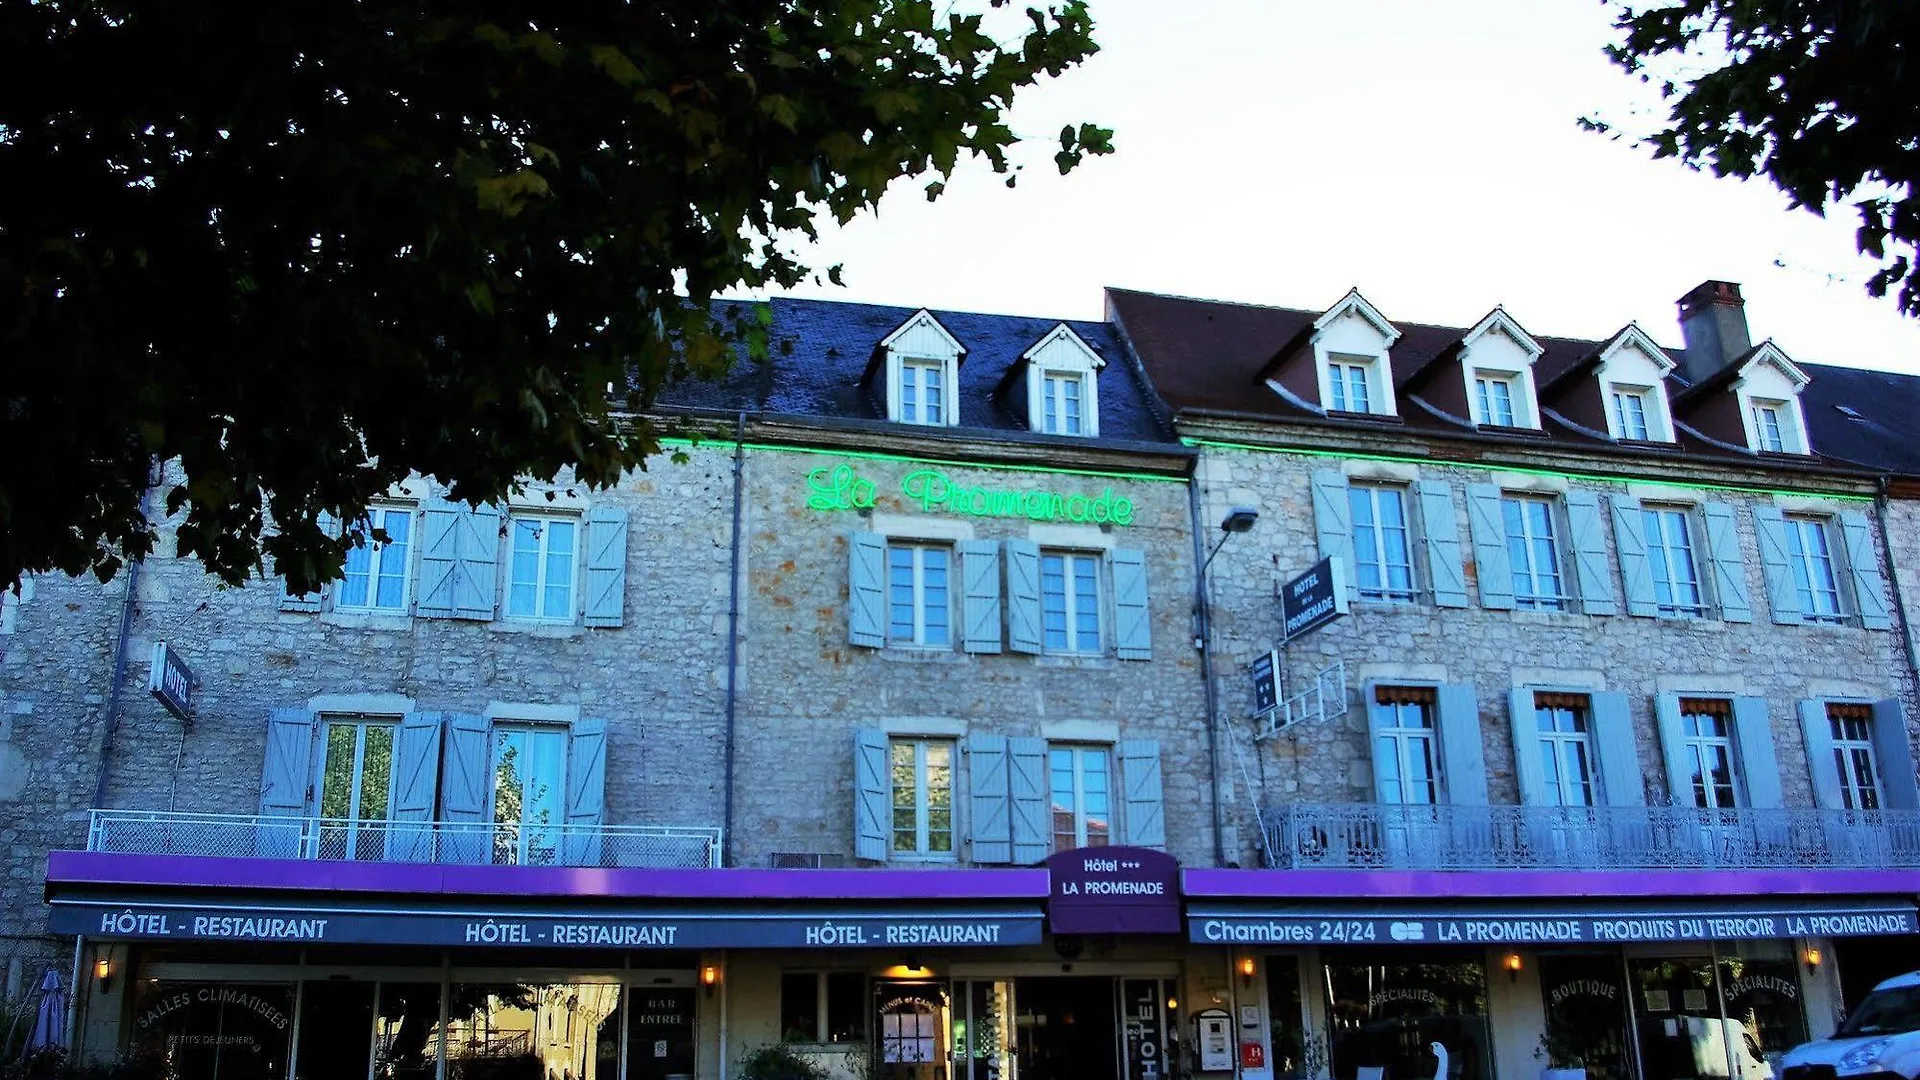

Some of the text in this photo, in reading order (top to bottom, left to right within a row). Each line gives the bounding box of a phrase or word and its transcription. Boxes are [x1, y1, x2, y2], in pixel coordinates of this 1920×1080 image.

[807, 464, 1135, 526] La Promenade
[1293, 573, 1319, 598] HOTEL
[1286, 595, 1334, 633] PROMENADE
[166, 661, 187, 703] HOTEL
[1083, 859, 1118, 873] Hôtel
[1062, 881, 1164, 896] LA PROMENADE
[101, 909, 171, 935] HÔTEL
[193, 916, 328, 939] RESTAURANT
[465, 918, 531, 943] HÔTEL
[552, 924, 678, 945] RESTAURANT
[806, 922, 867, 945] HÔTEL
[886, 924, 1000, 945] RESTAURANT
[1204, 920, 1314, 942] Chambres
[1320, 921, 1376, 942] 24/24
[1437, 920, 1582, 941] LA PROMENADE
[1592, 917, 1776, 940] PRODUITS DU TERROIR
[1786, 914, 1910, 936] LA PROMENADE
[1551, 979, 1617, 1001] BOUTIQUE
[1725, 977, 1797, 1001] SPECIALITES
[137, 988, 289, 1030] SALLES CLIMATISEES
[648, 999, 675, 1009] BAR
[640, 1014, 684, 1024] ENTREE
[1138, 987, 1159, 1080] HOTEL
[1251, 1047, 1261, 1057] H
